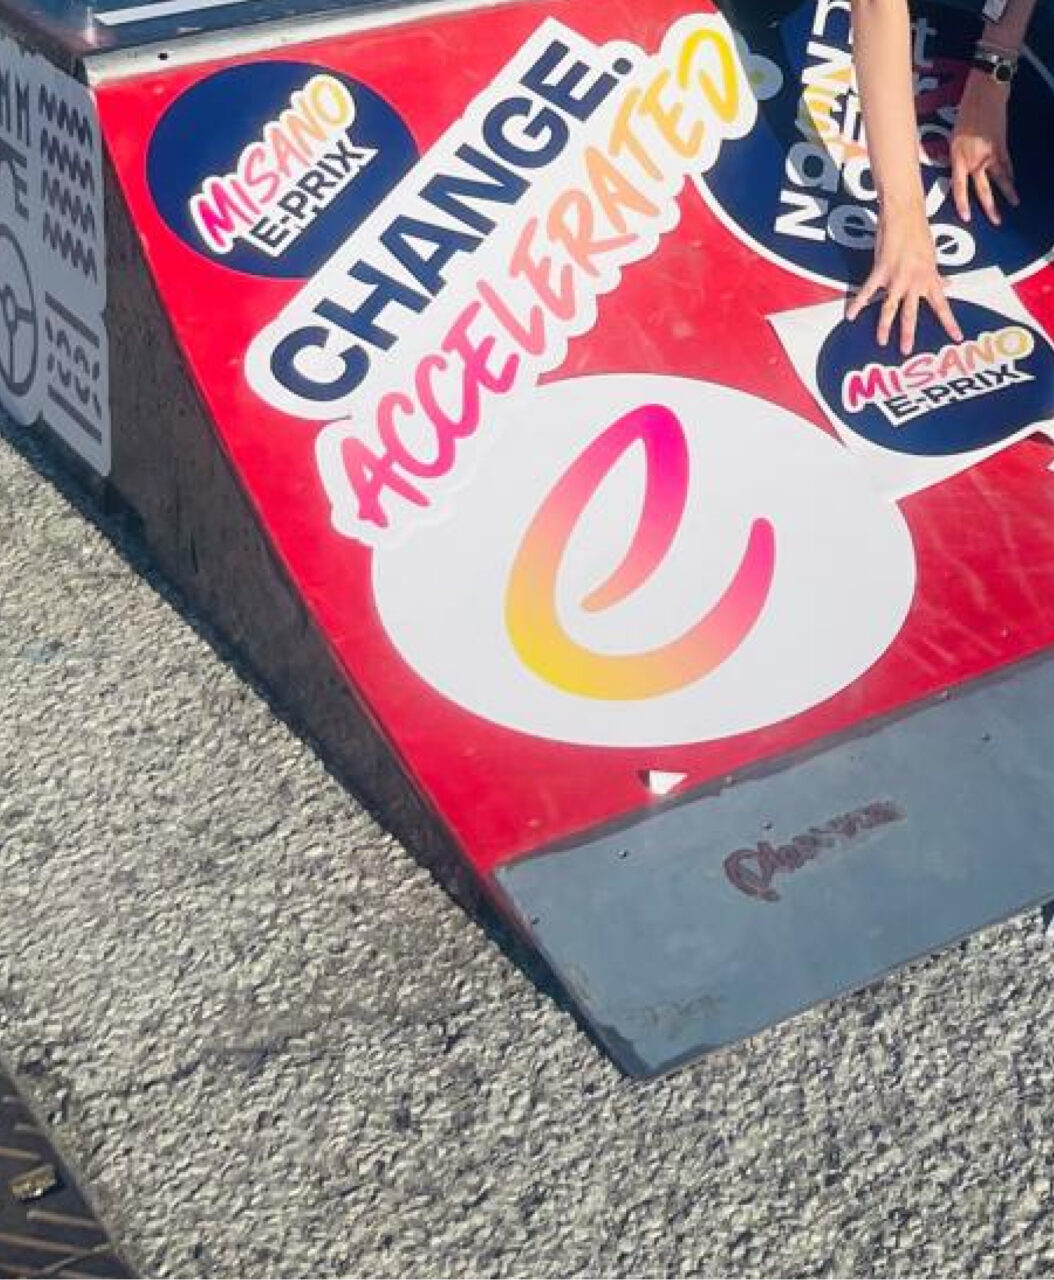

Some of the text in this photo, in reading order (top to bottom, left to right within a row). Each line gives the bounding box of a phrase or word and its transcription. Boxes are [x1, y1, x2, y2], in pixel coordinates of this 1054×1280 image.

[198, 81, 348, 248] MISANO
[249, 140, 365, 249] E-PRIX
[270, 39, 633, 402] CHANGE.
[849, 329, 1028, 409] MISANO
[884, 364, 1022, 418] E-PRIX
